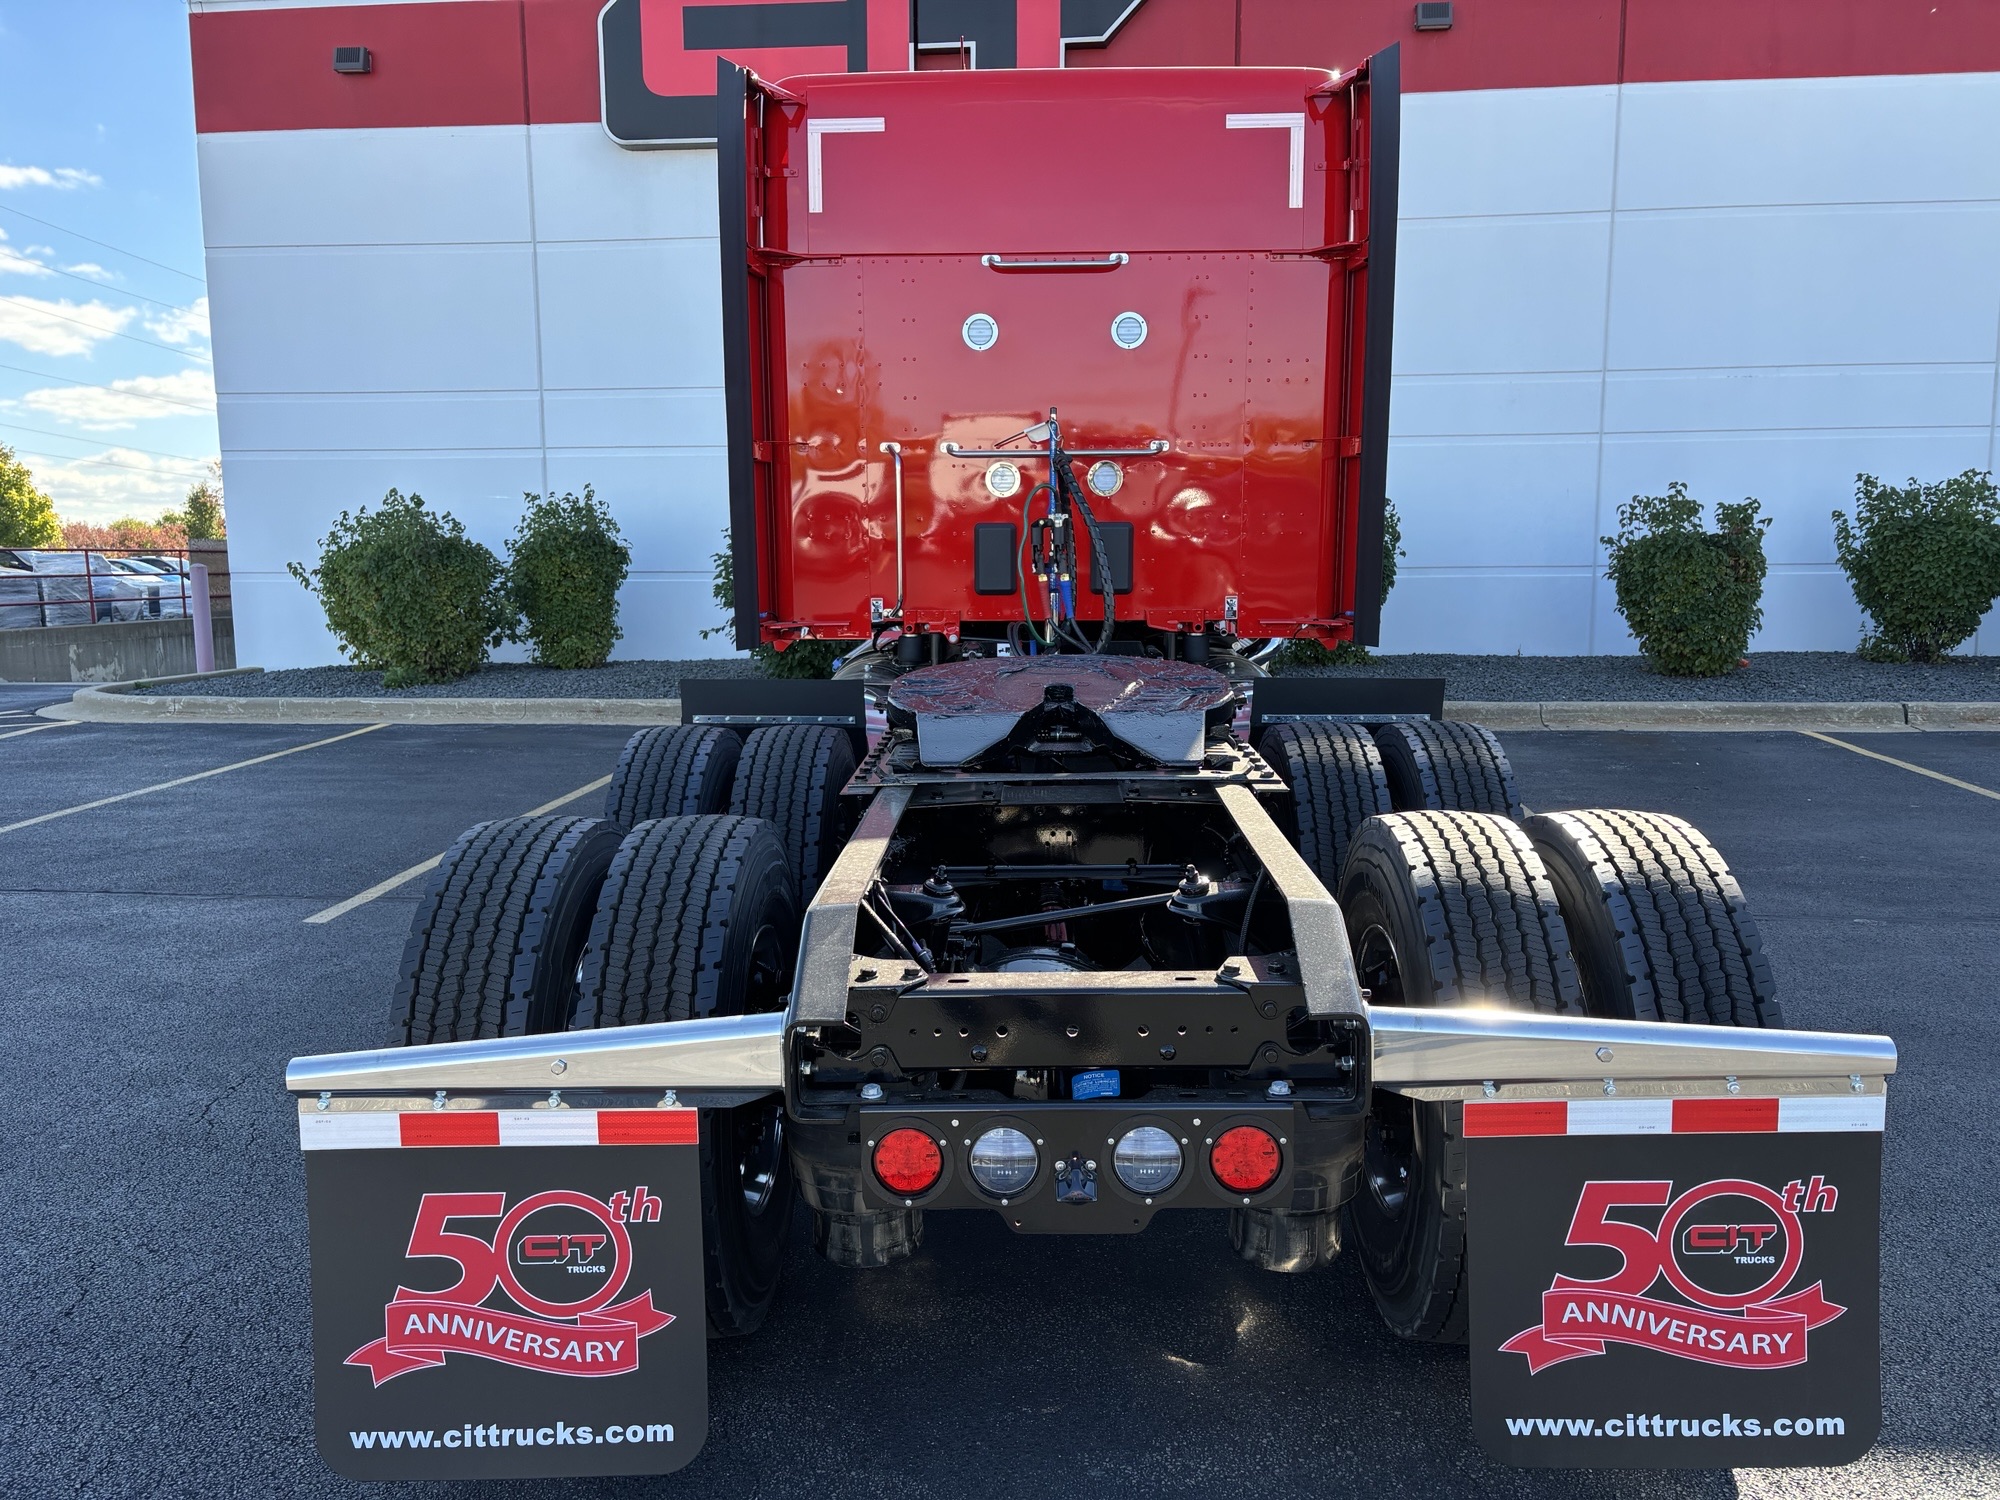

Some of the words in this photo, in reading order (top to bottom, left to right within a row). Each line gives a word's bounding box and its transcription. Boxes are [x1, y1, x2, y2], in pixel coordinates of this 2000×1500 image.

[519, 1235, 606, 1260] CIT
[1685, 1225, 1777, 1250] CIT
[566, 1265, 606, 1274] TRUCKS
[1733, 1256, 1776, 1265] TRUCKS
[404, 1313, 625, 1363] ANNIVERSARY
[1561, 1301, 1793, 1356] ANNIVERSARY
[349, 1421, 674, 1449] www.cittrucks.com
[1505, 1413, 1846, 1438] www.cittrucks.com
